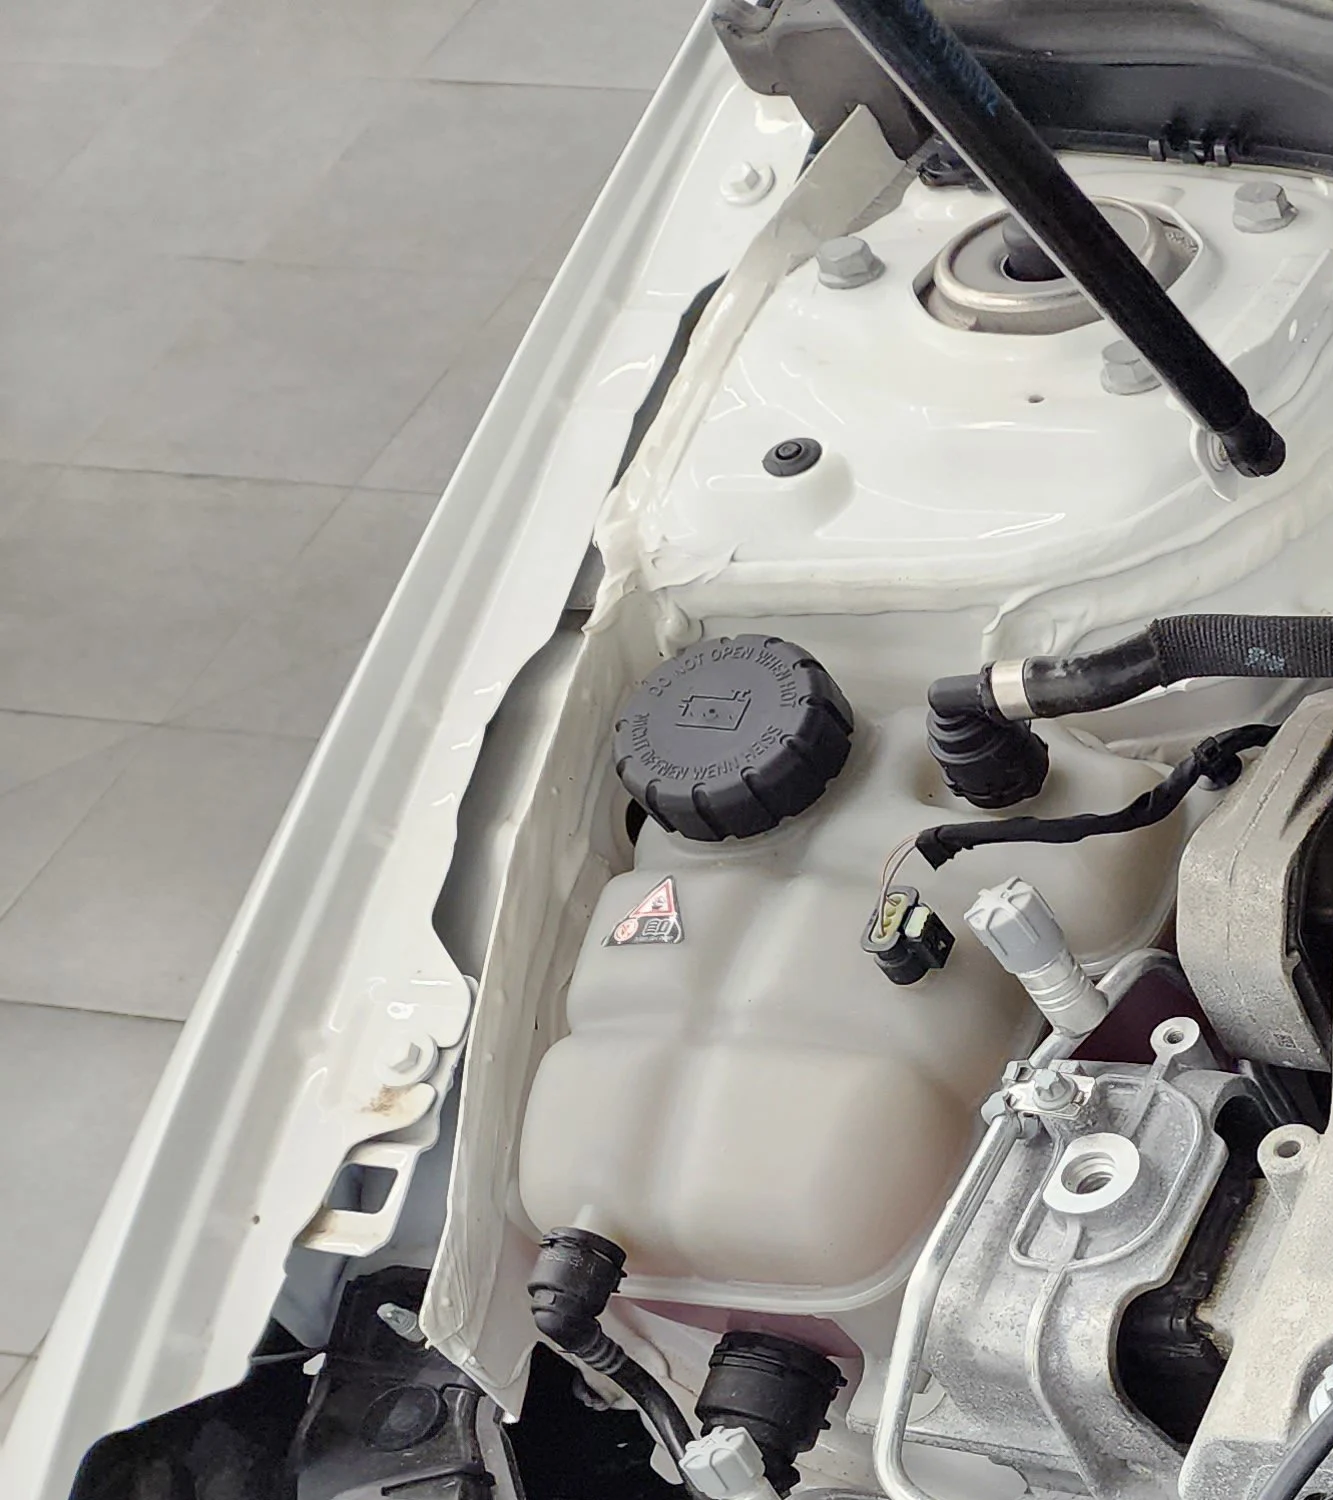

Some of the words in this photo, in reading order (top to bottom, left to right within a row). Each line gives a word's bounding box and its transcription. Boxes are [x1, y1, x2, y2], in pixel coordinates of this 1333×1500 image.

[711, 646, 754, 662] OPEN
[755, 650, 792, 682] WHEN
[780, 681, 797, 709] HOT
